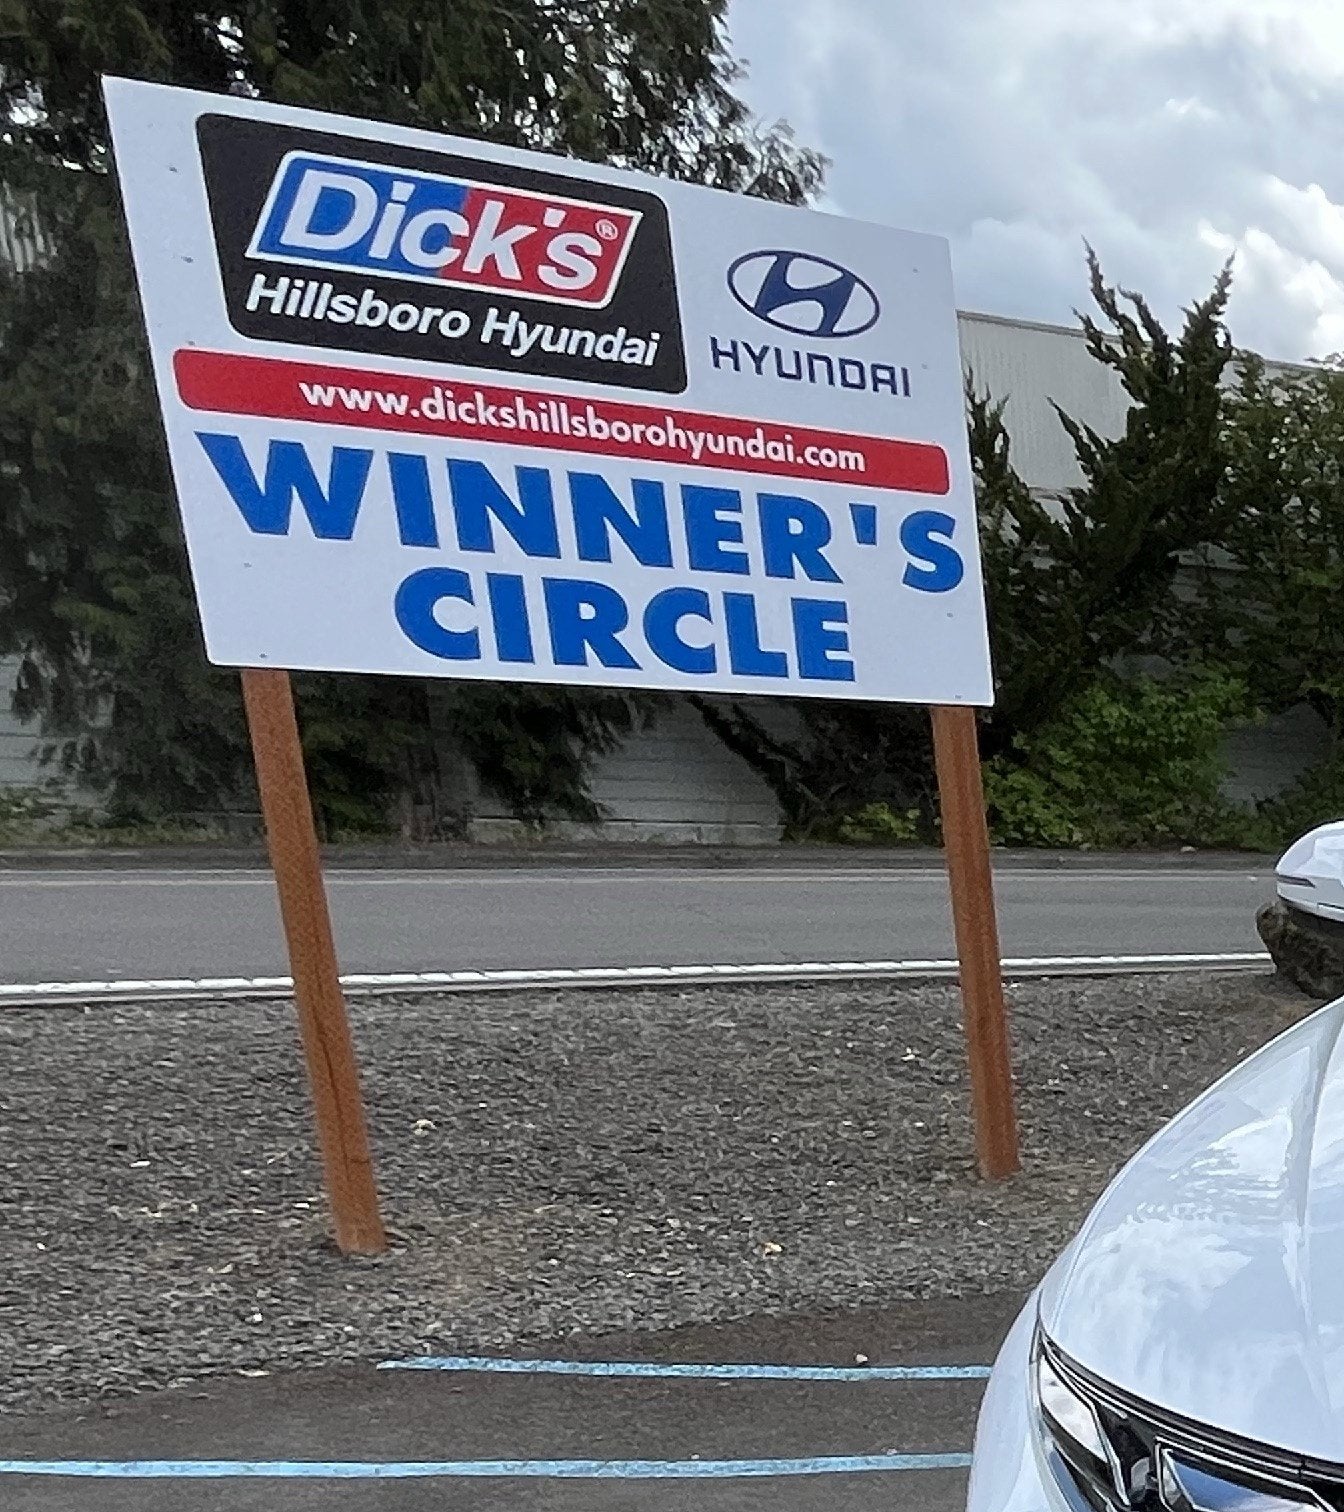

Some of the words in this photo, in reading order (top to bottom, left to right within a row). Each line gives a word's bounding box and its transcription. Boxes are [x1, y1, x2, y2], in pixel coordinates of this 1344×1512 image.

[281, 170, 602, 292] Dick's
[246, 273, 470, 340] Hillsboro
[479, 307, 661, 368] Hyundai
[709, 335, 912, 400] HYUNDAI
[299, 377, 866, 474] www.dickshillsborohyundai.com
[195, 430, 964, 593] WINNER'S
[394, 567, 856, 683] CIRCLE
